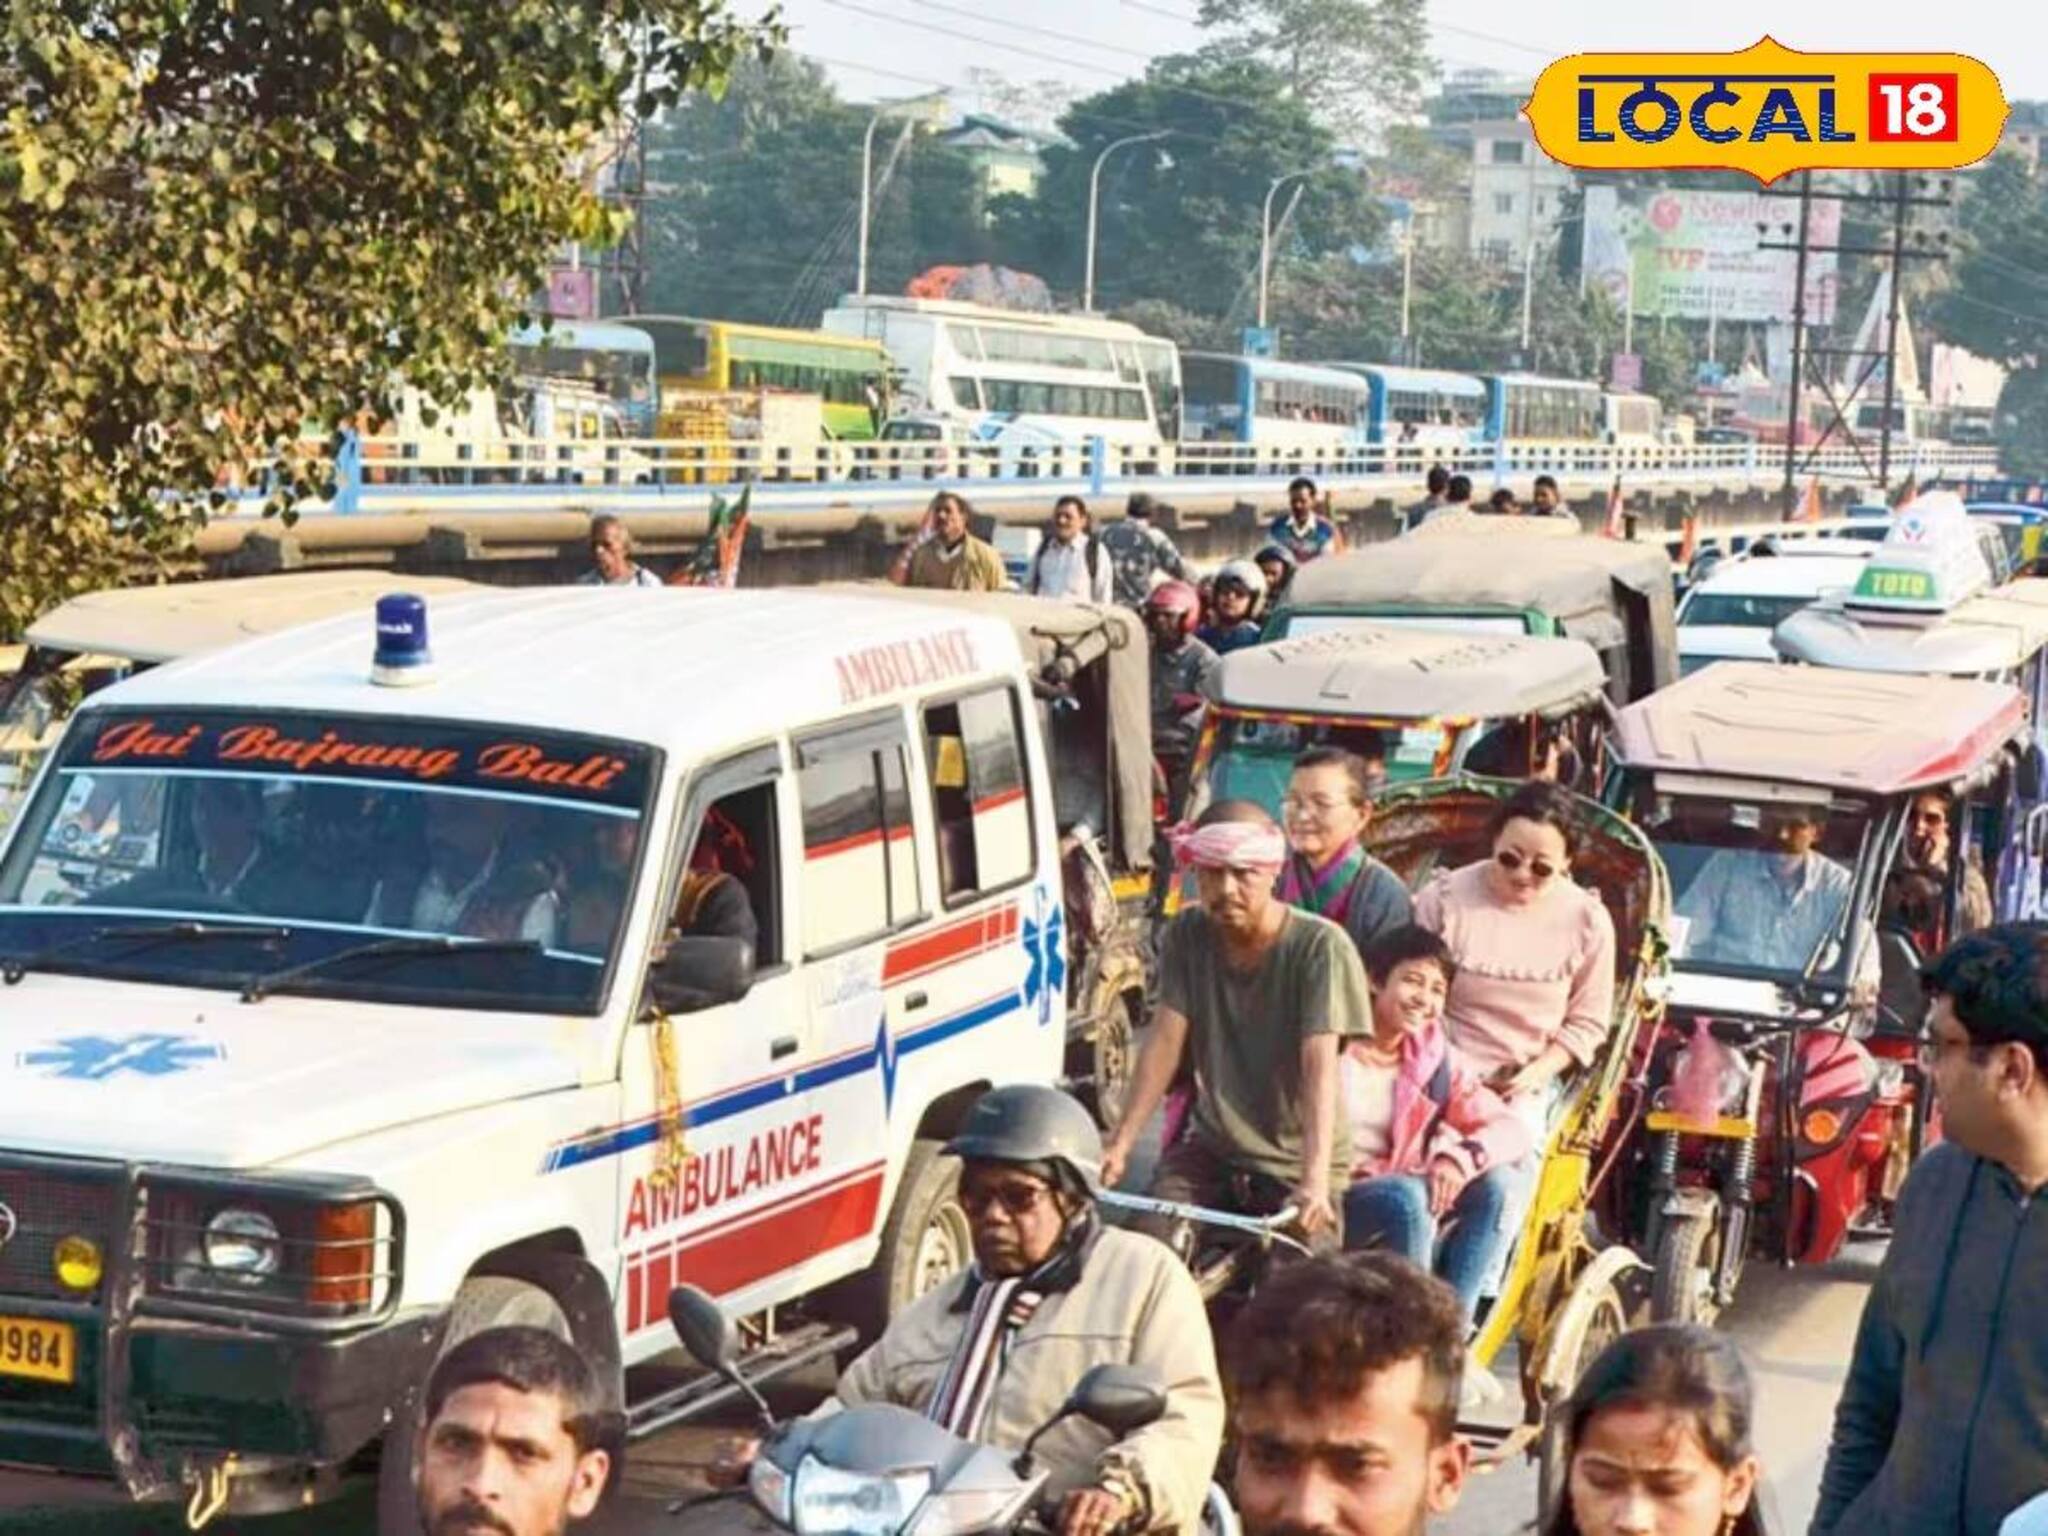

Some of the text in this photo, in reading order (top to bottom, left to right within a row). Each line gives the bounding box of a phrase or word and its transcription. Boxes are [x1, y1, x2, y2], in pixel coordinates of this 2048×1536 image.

[1871, 572, 1927, 597] TOTO
[834, 628, 980, 704] AMBULANCE
[93, 716, 627, 791] Jai Bajrang Bali
[624, 1114, 824, 1239] AMBULANCE
[0, 1325, 62, 1369] 984
